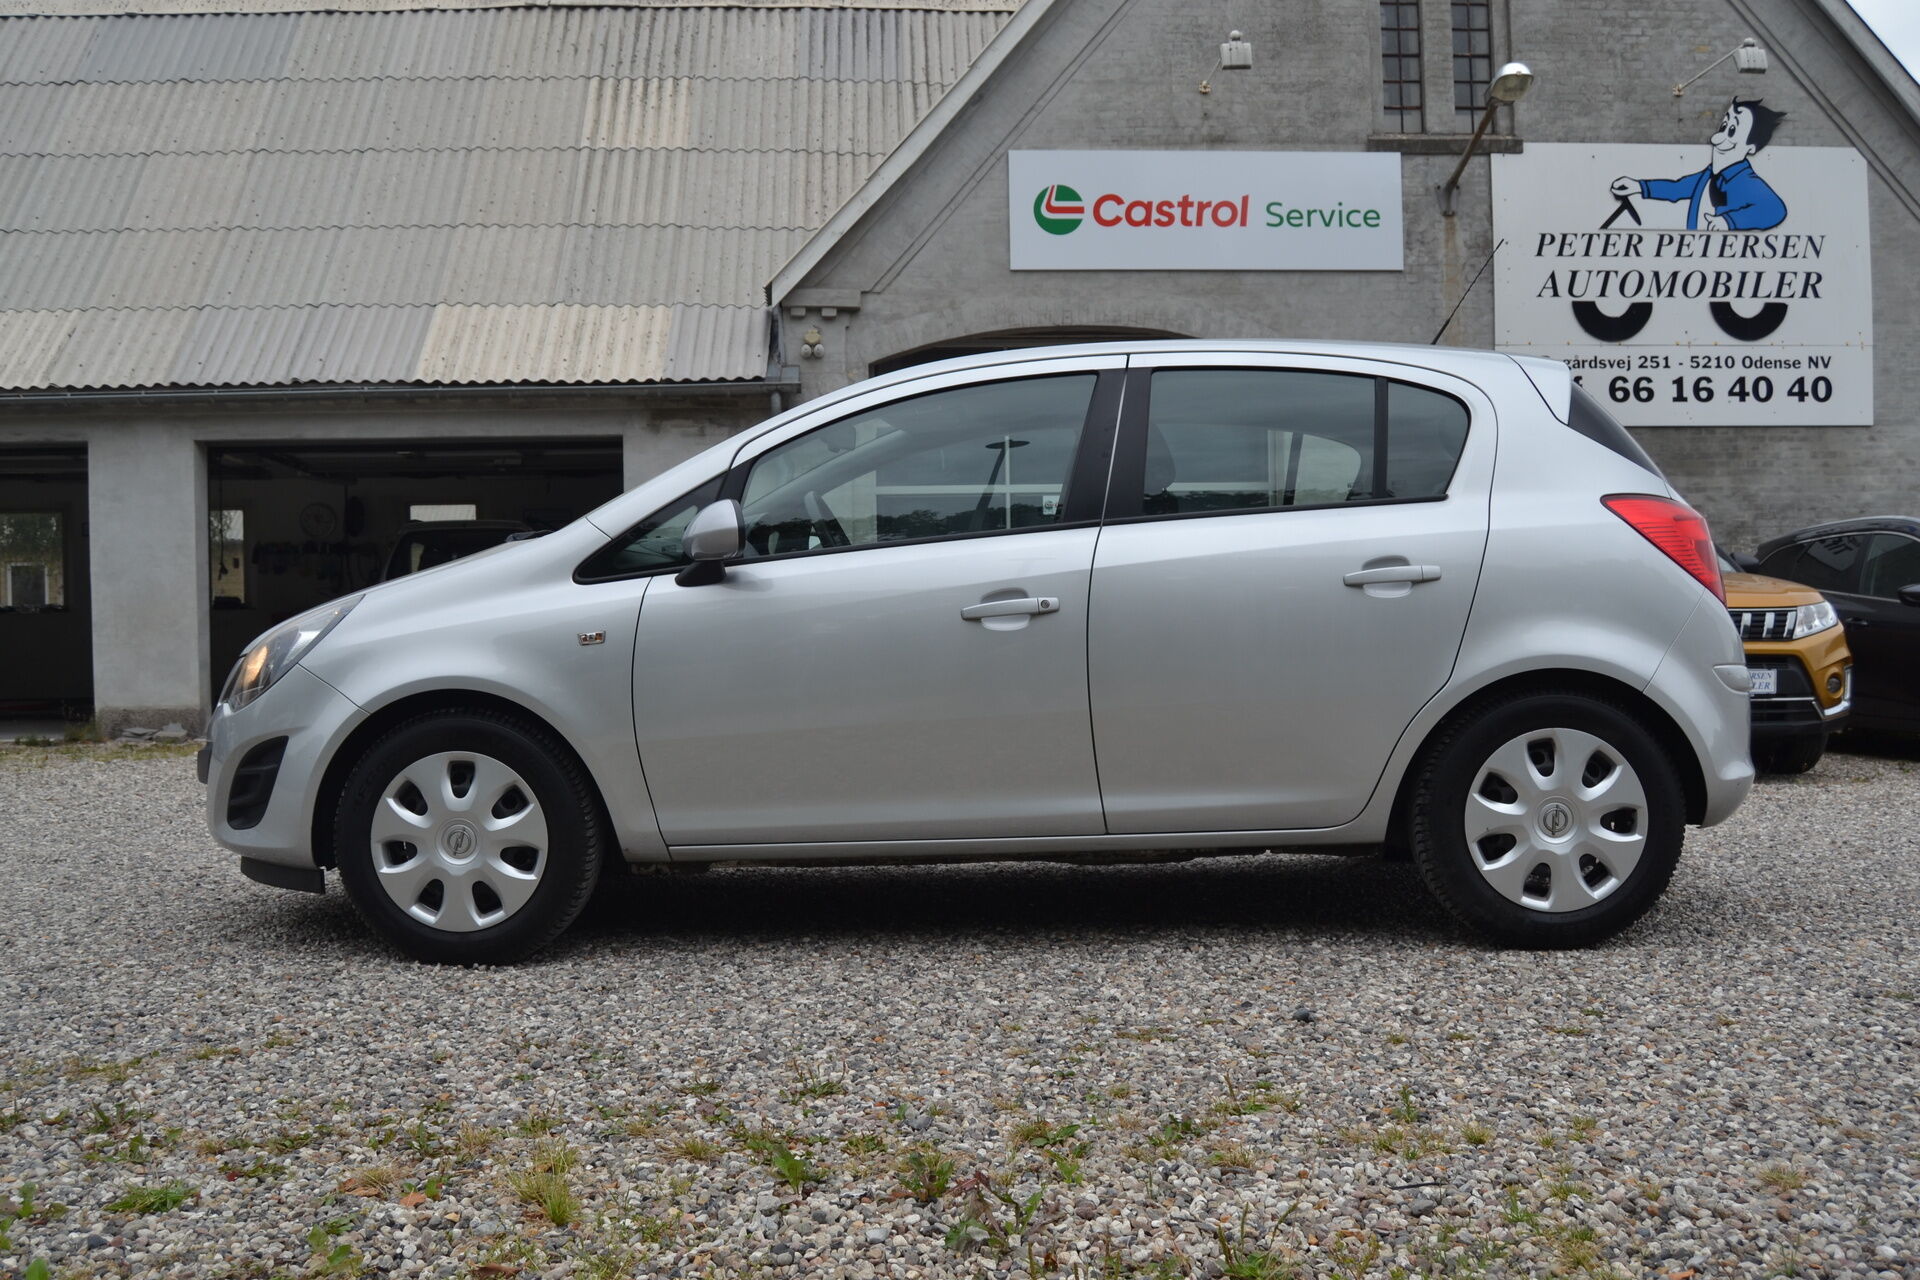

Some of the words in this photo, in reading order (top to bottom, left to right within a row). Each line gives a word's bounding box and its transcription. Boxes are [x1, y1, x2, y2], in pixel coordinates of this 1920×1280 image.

[1093, 194, 1249, 227] Castrol
[1265, 201, 1382, 228] Service
[1534, 232, 1644, 258] PETER
[1653, 233, 1827, 260] PETERSEN
[1536, 269, 1823, 300] AUTOMOBILER
[1541, 354, 1632, 371] gårdsvej
[1638, 355, 1671, 369] 251
[1690, 355, 1735, 369] 5210
[1741, 355, 1802, 369] Odense
[1807, 355, 1832, 369] NV
[1608, 375, 1655, 403] 66
[1671, 375, 1715, 403] 16
[1727, 375, 1774, 403] 40
[1786, 375, 1833, 403] 40
[1750, 672, 1772, 680] RSEN
